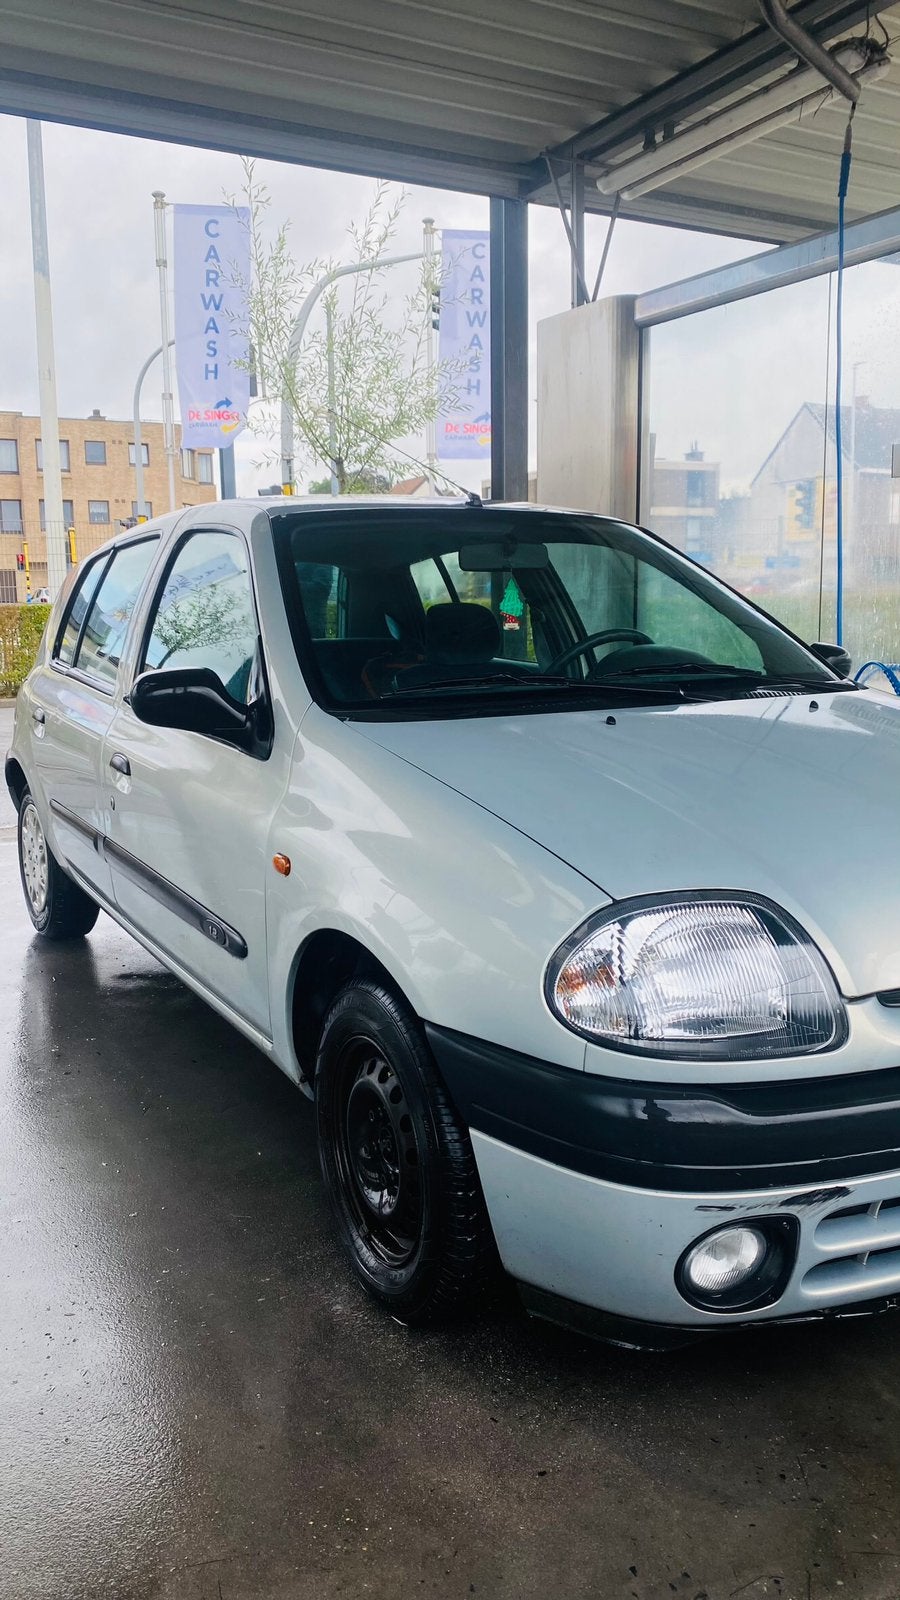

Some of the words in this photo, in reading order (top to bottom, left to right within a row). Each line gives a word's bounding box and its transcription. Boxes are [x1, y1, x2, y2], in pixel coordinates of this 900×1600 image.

[200, 219, 224, 380] CARWASH
[465, 243, 487, 396] CARWASH
[463, 423, 492, 434] SING
